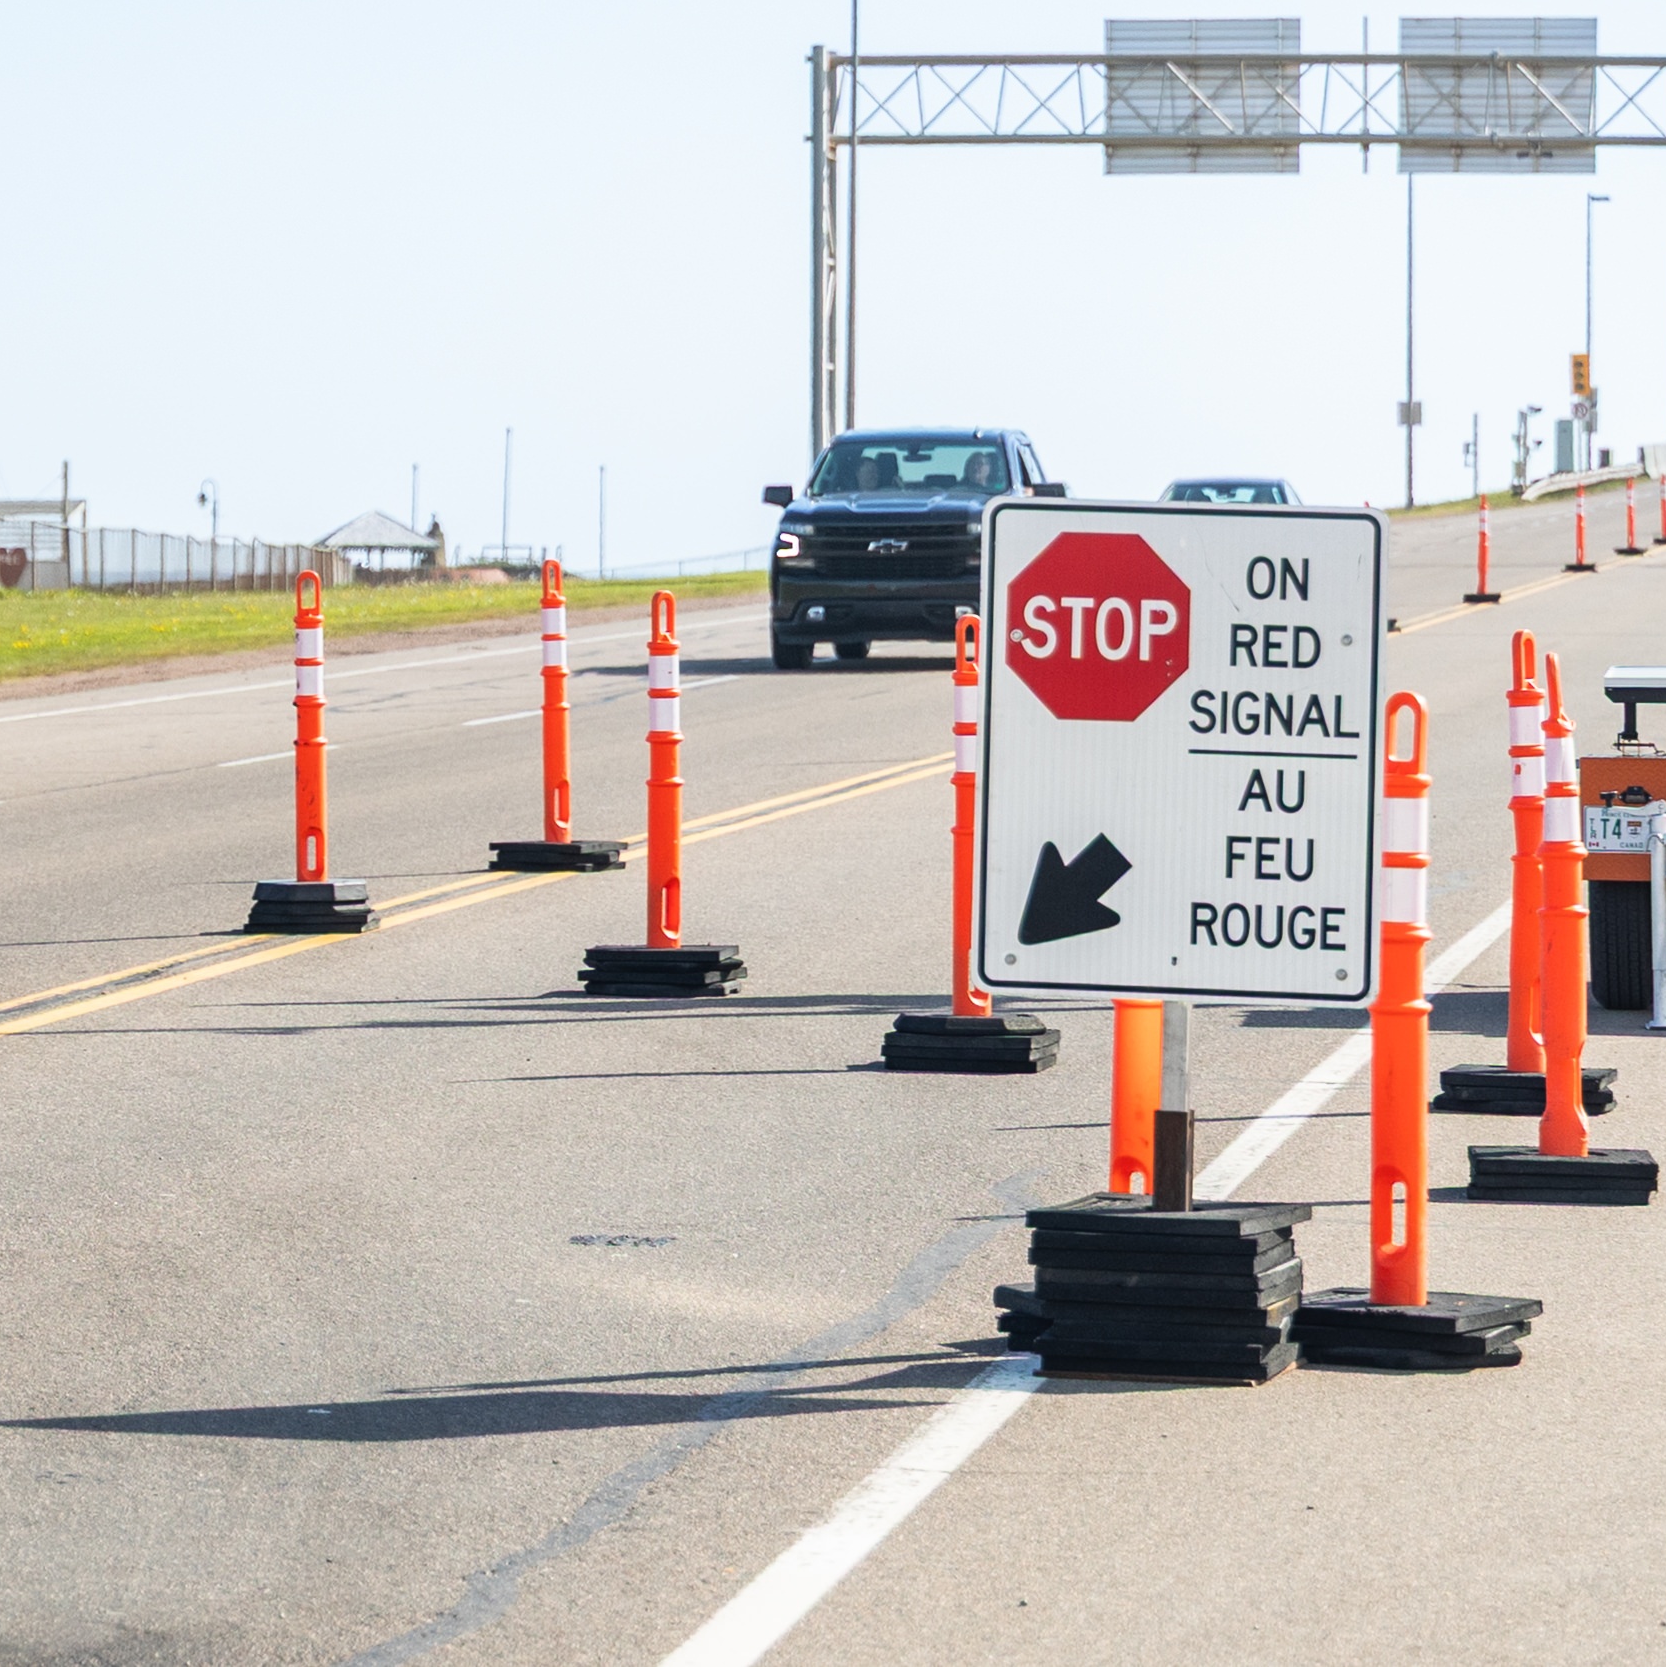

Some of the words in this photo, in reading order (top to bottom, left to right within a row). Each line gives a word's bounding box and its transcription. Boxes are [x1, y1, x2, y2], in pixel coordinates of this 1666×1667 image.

[1246, 556, 1310, 601] ON
[1021, 595, 1178, 661] STOP
[1230, 624, 1322, 669] RED
[1188, 690, 1360, 738] SIGNAL
[1238, 769, 1306, 814] AU
[1225, 836, 1314, 882] FEU
[1190, 901, 1346, 952] ROUGE
